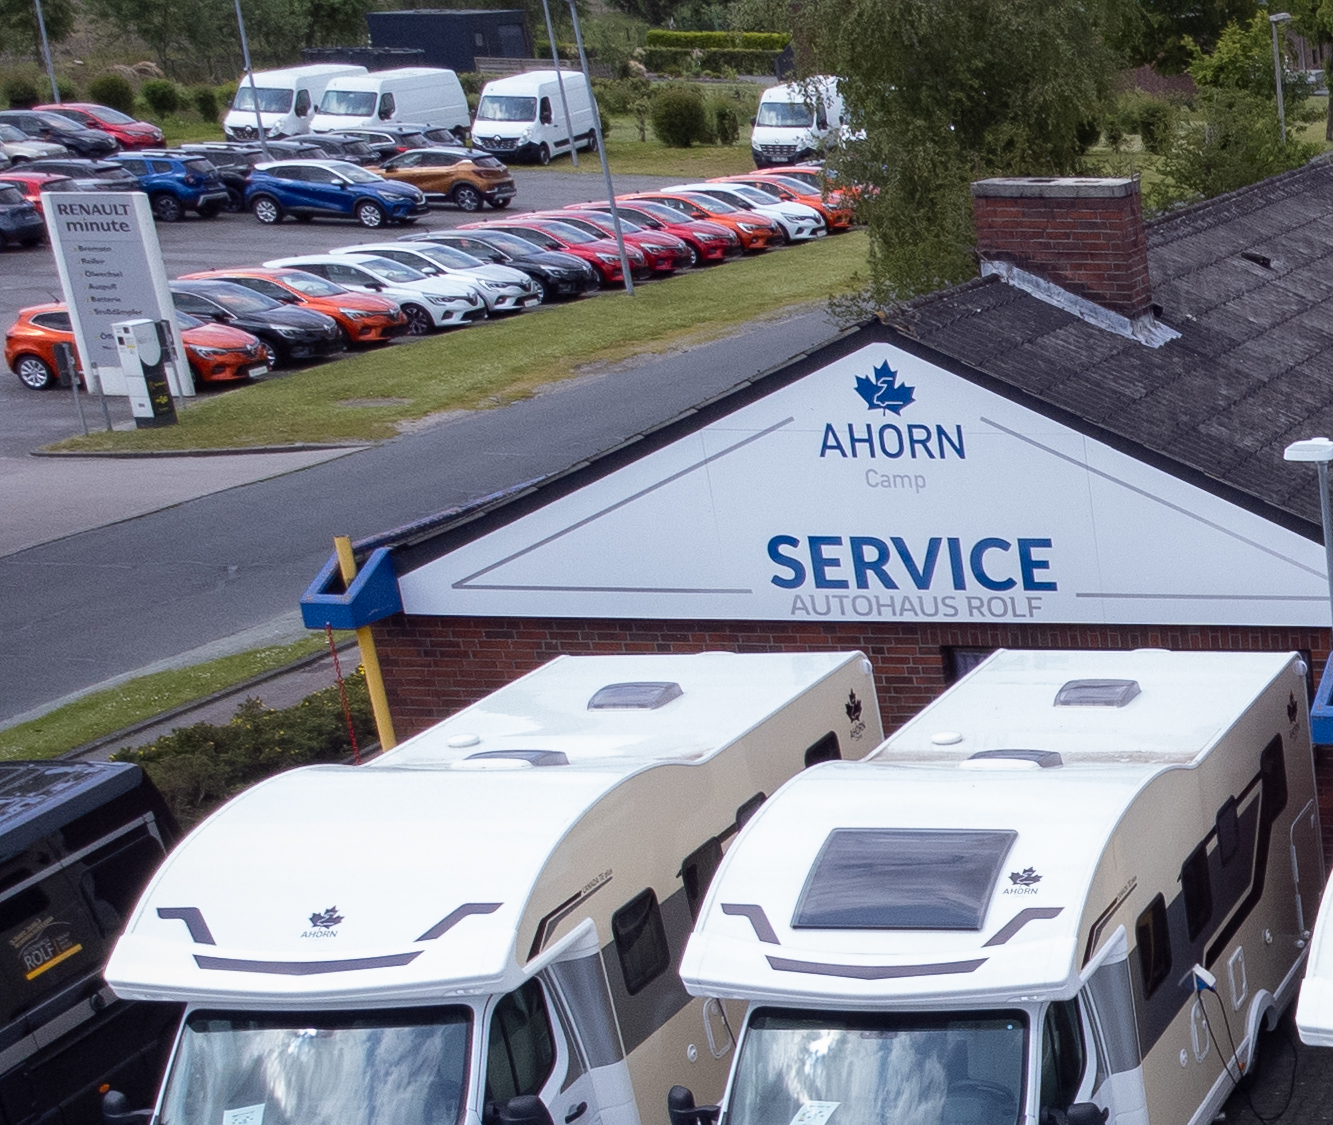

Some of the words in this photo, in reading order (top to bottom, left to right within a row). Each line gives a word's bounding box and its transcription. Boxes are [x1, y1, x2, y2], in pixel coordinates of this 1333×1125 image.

[57, 204, 131, 216] RENAULT
[66, 219, 131, 233] minute
[819, 423, 966, 460] AHORN
[865, 468, 927, 494] Camp
[767, 534, 1058, 592] SERVICE
[790, 594, 959, 618] AUTOHAUS
[966, 596, 1043, 618] ROLF
[300, 930, 338, 938] AHORN
[24, 942, 54, 970] ROLF
